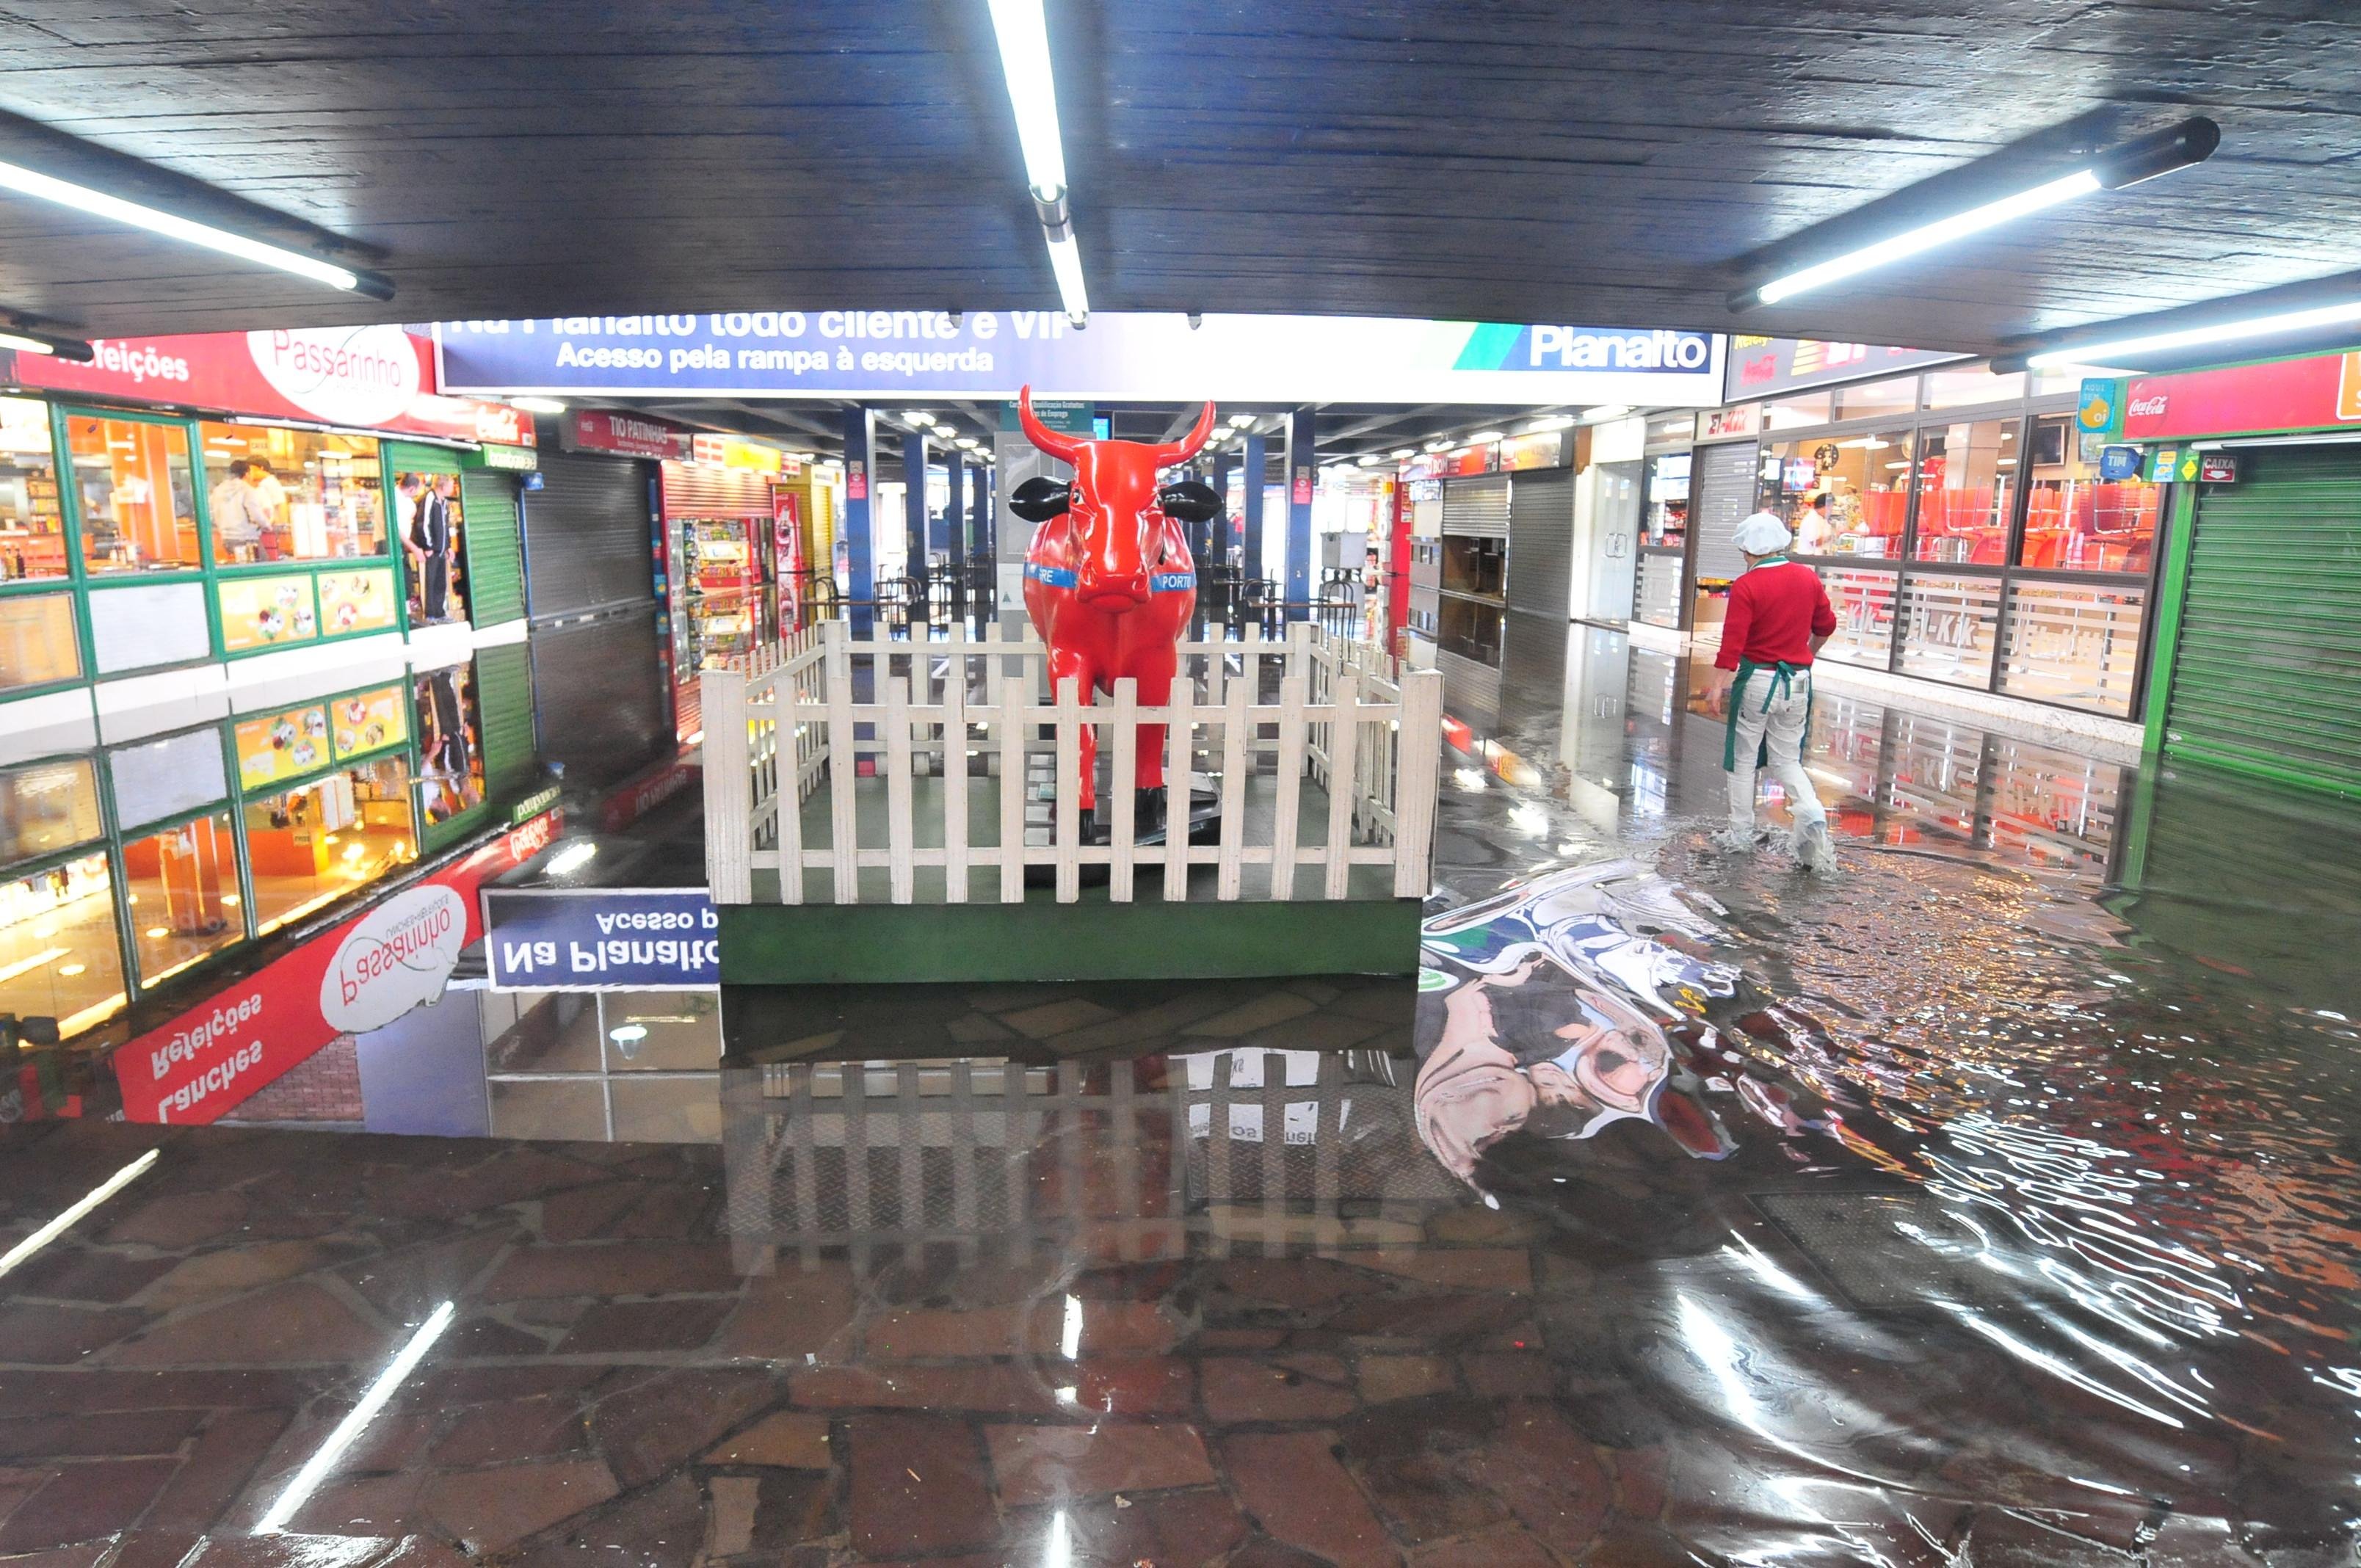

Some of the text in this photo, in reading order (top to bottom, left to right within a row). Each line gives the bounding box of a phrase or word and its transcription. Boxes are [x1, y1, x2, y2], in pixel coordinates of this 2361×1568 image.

[272, 329, 402, 387] Passarinho
[1529, 324, 1708, 369] Planalto
[59, 339, 190, 382] feições
[556, 341, 994, 377] Acesso pela rampa à esquerda
[2093, 410, 2108, 423] oi
[2128, 396, 2169, 417] Coca-Cola
[609, 415, 626, 438] TIO
[2107, 455, 2128, 467] TIM
[2204, 457, 2235, 470] CAIXA
